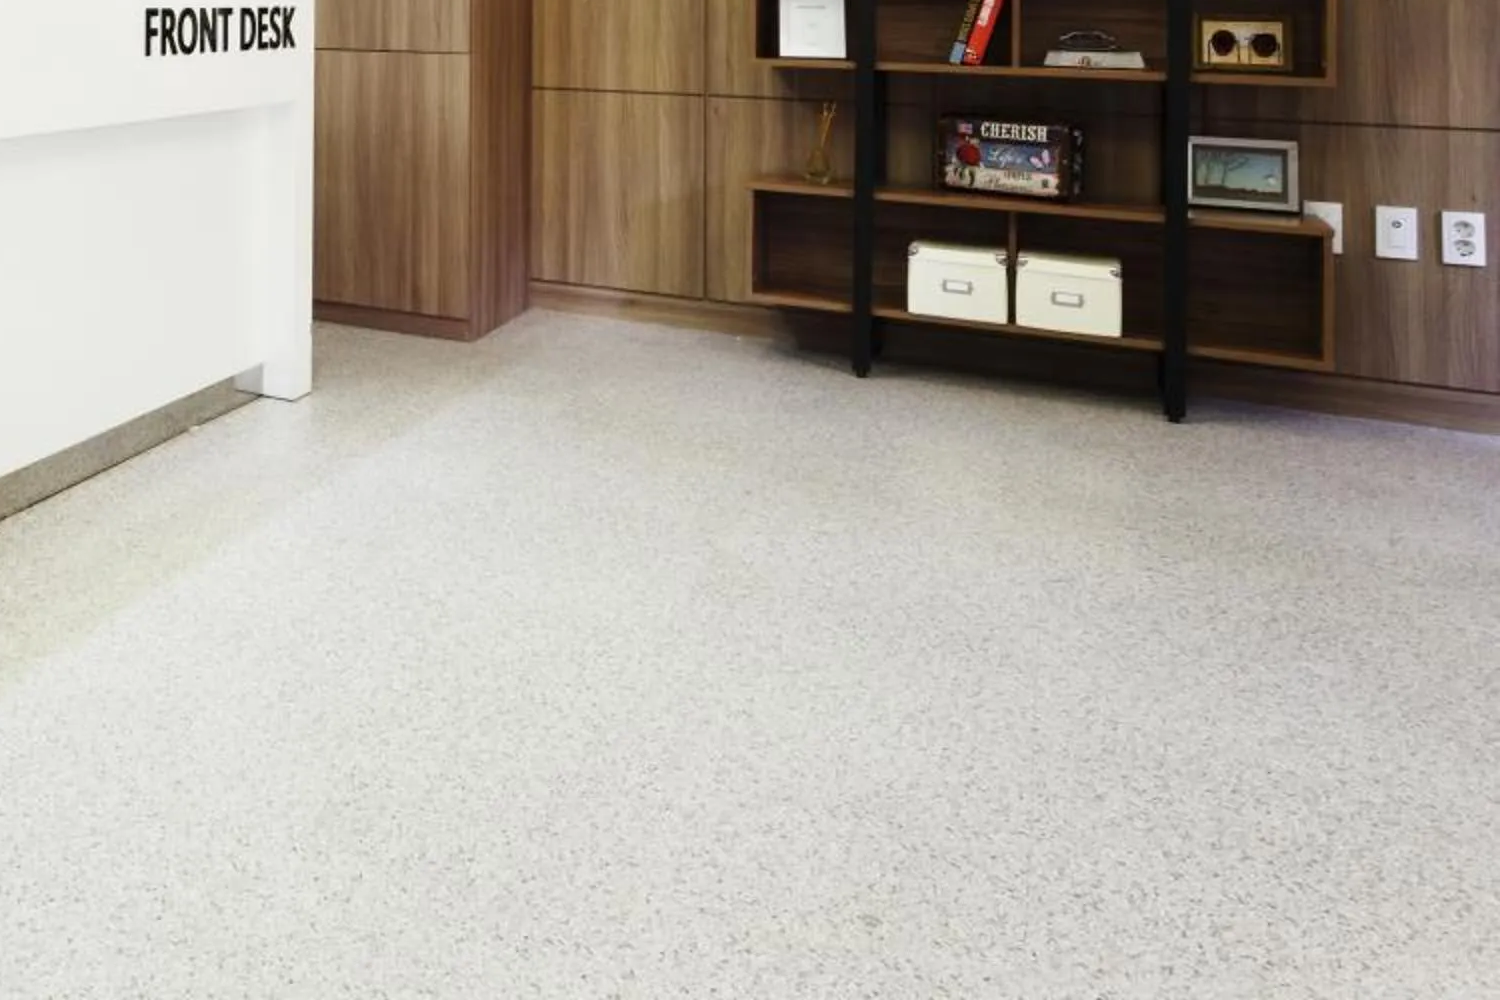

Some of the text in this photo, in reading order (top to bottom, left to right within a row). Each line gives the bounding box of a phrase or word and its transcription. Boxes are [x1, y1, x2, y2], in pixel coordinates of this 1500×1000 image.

[145, 6, 296, 57] FRONT DESK
[980, 121, 1048, 143] CHERISH
